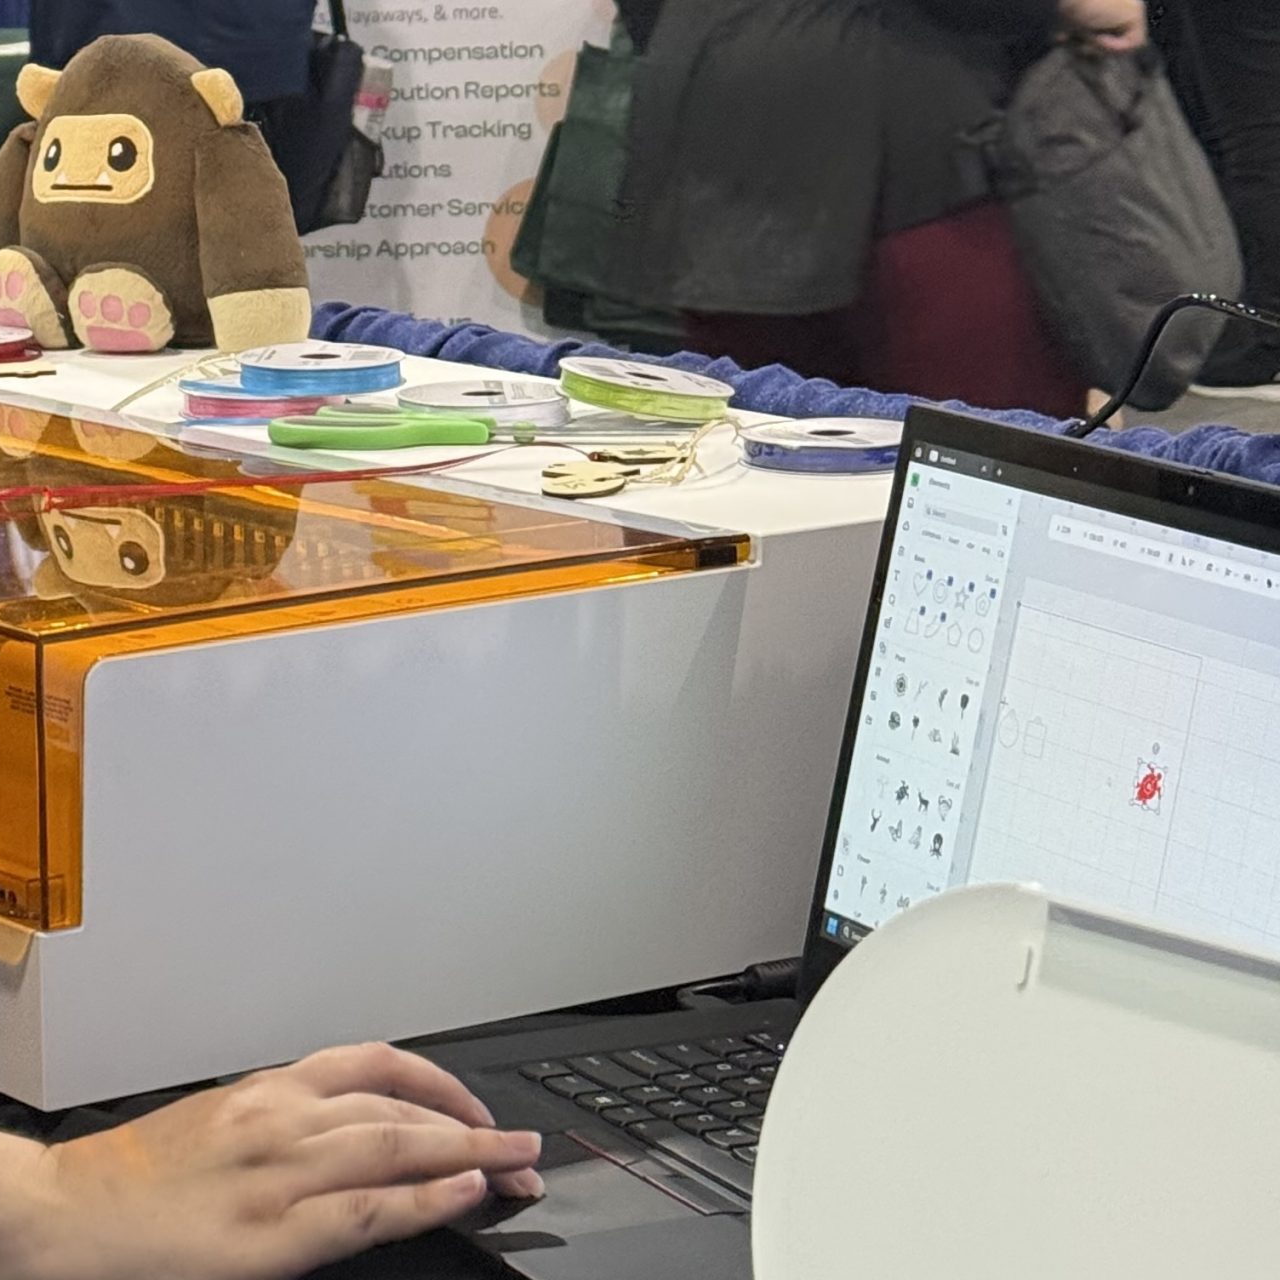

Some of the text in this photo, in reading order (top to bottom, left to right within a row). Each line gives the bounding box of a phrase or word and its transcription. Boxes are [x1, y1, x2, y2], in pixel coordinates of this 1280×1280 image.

[348, 4, 503, 27] layaways, & more.
[370, 41, 545, 65] Compensation
[464, 81, 561, 104] Reports
[426, 119, 532, 140] Tracking
[366, 198, 526, 219] tomer Servic
[376, 238, 496, 259] Approach
